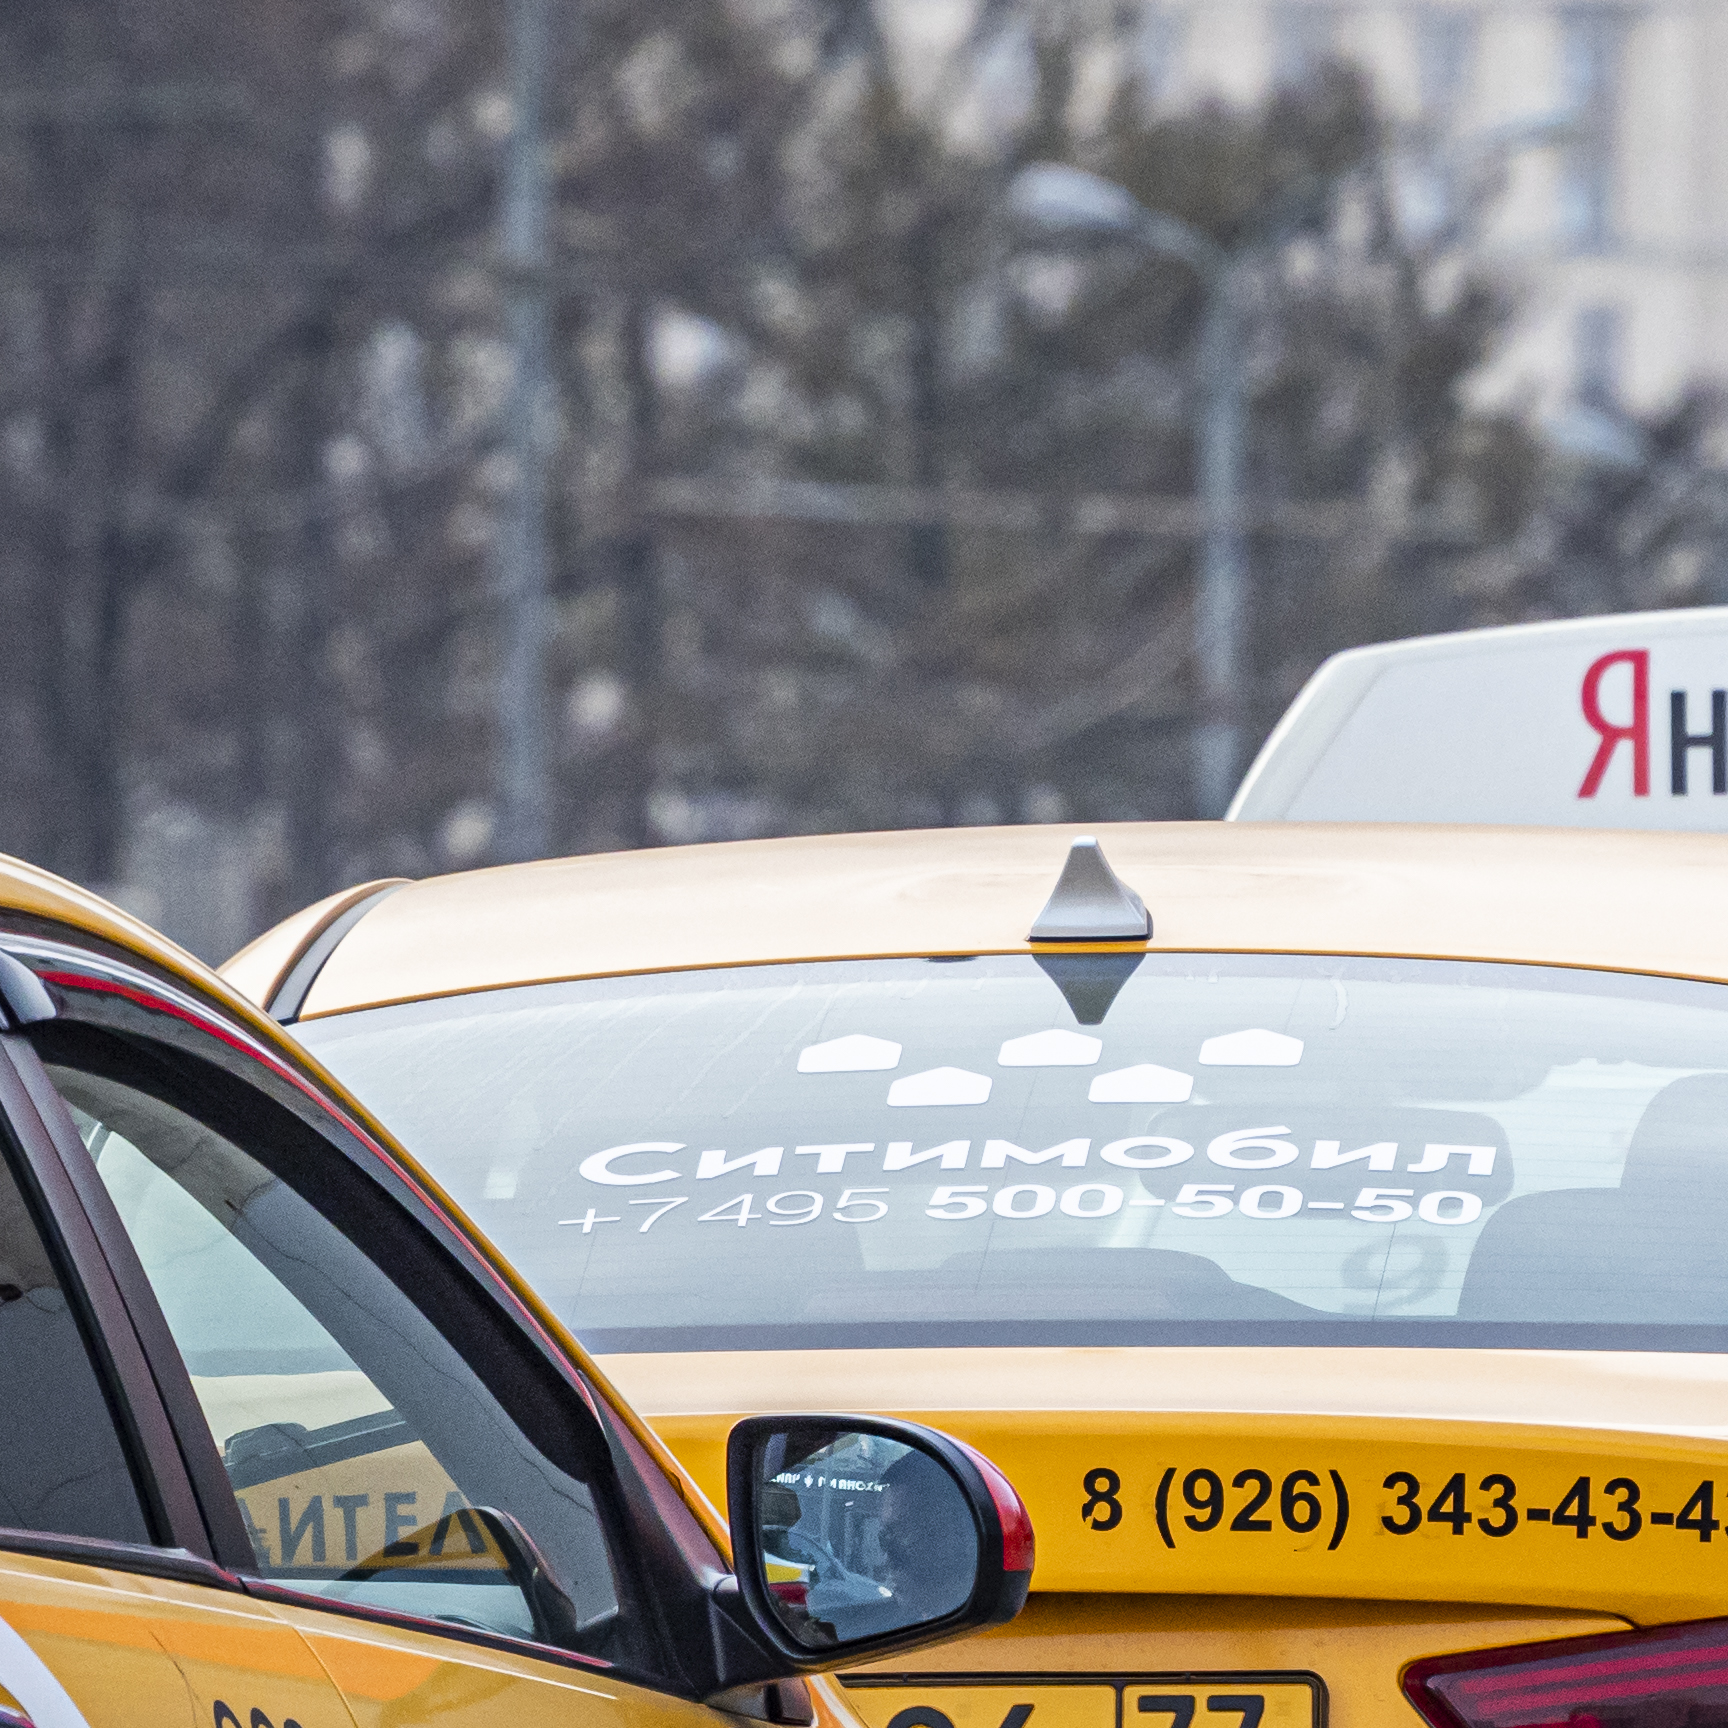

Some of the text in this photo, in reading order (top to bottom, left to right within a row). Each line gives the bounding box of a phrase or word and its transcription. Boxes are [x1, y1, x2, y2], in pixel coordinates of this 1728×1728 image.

[578, 1125, 1497, 1186] Ситимобил
[925, 1183, 1483, 1226] 500-50-50
[1081, 1466, 1124, 1532] 8
[1153, 1466, 1350, 1550] (926)
